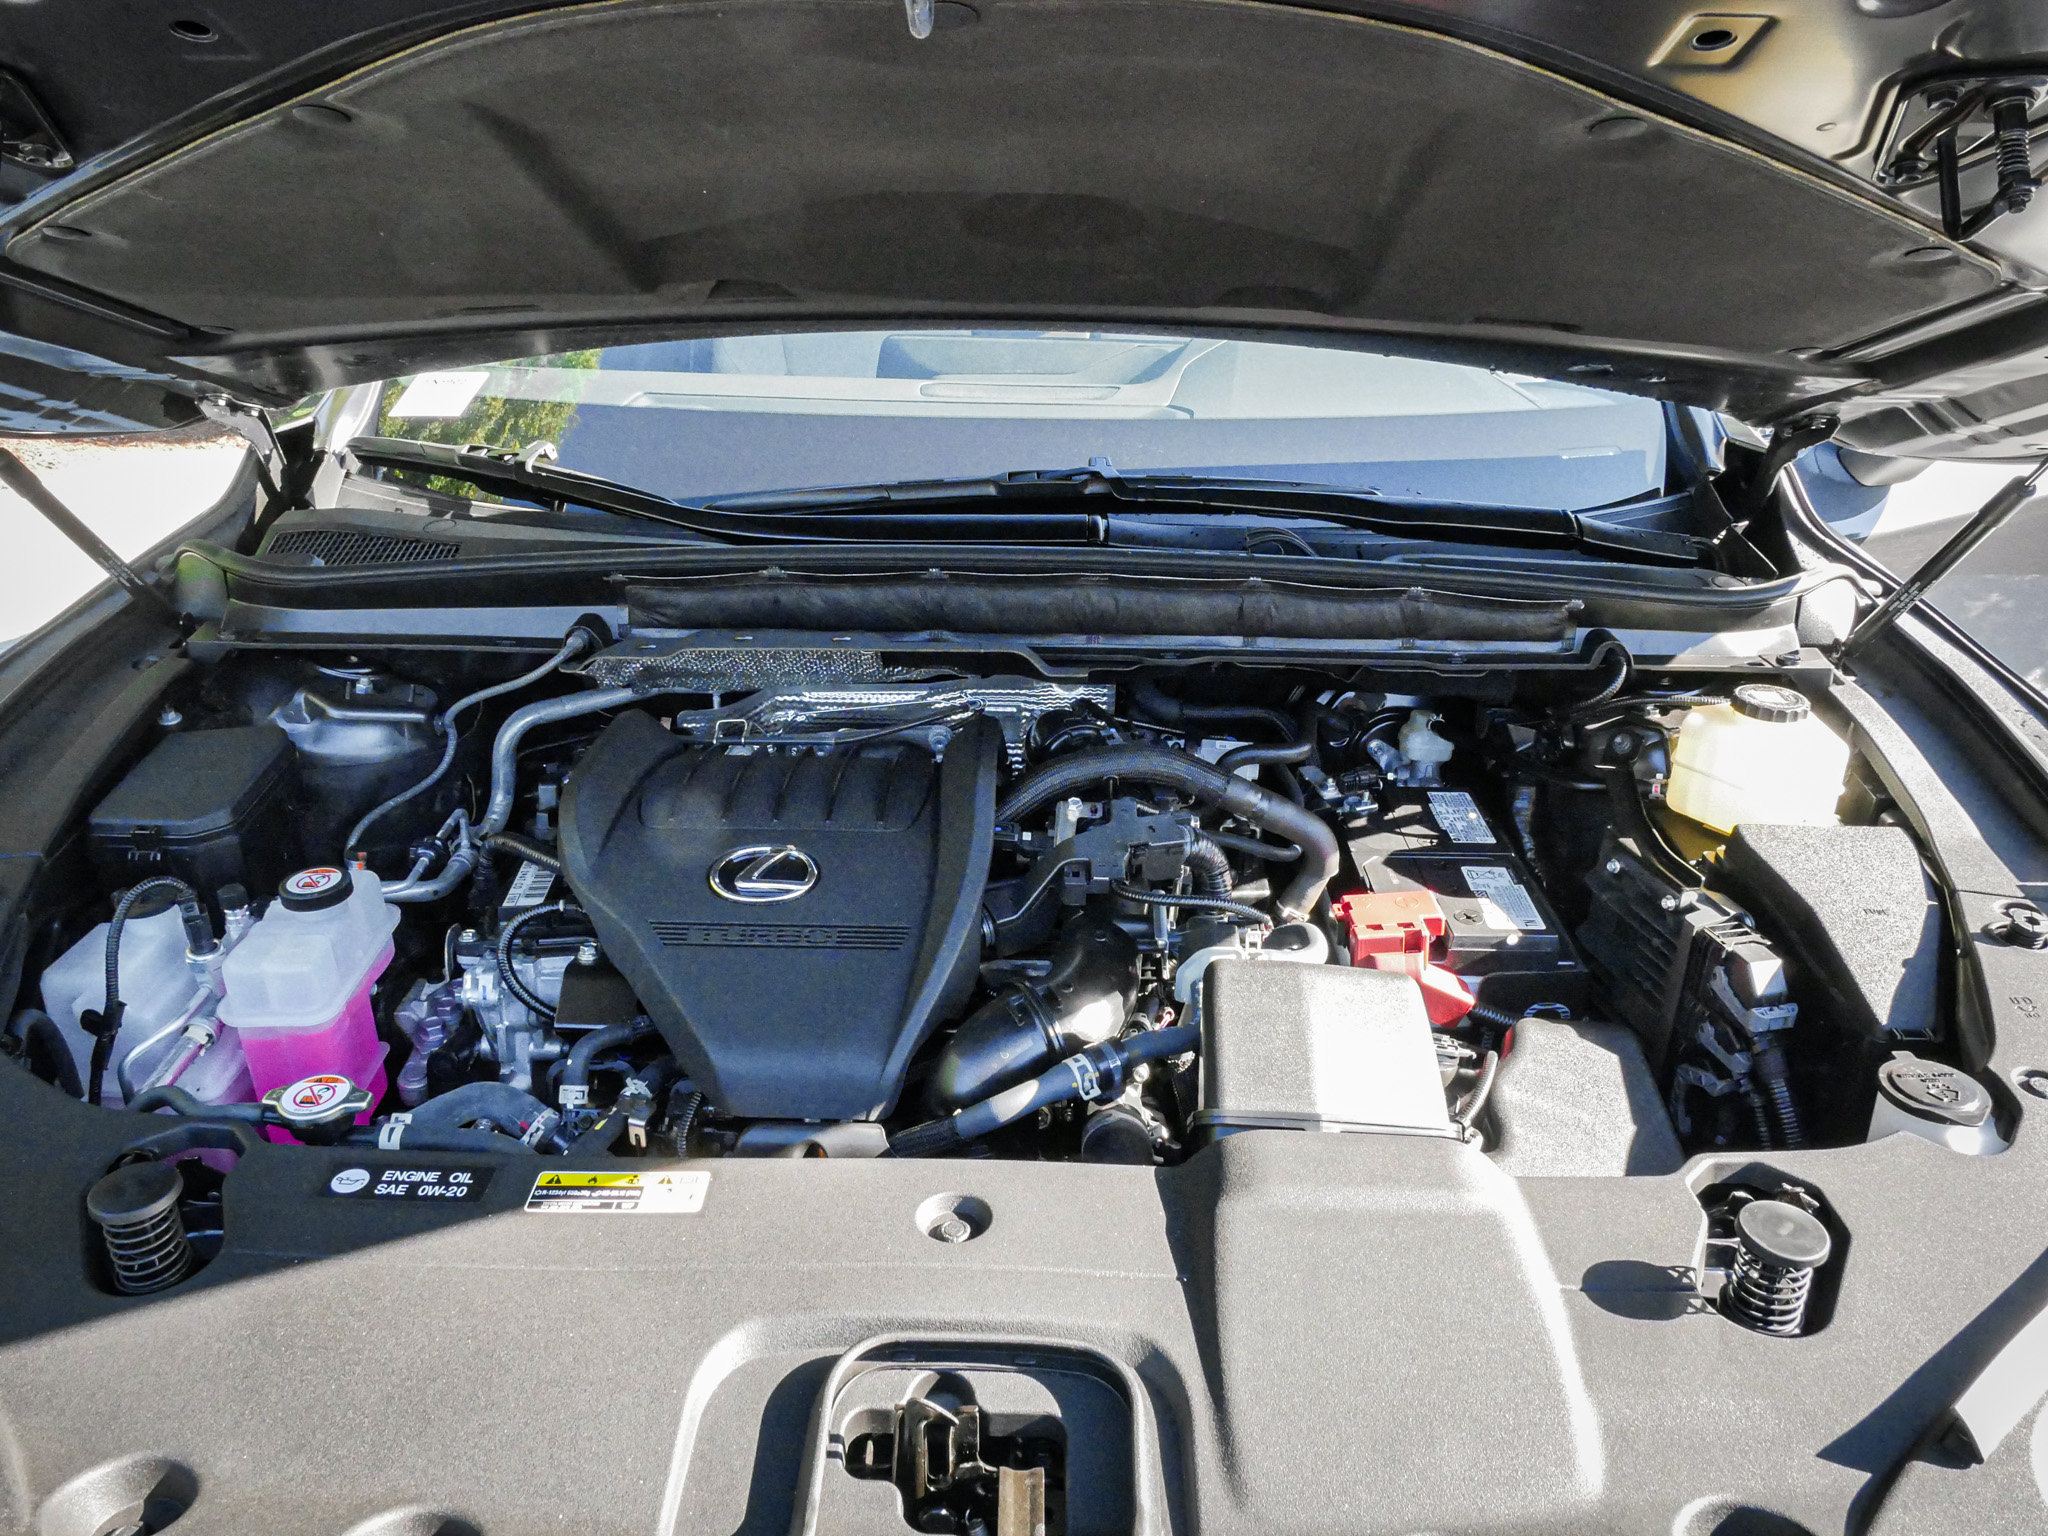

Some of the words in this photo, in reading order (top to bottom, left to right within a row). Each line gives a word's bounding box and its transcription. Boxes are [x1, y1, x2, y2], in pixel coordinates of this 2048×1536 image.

[690, 928, 833, 944] TURBO
[381, 1170, 441, 1183] ENGINE
[448, 1172, 474, 1184] OIL
[374, 1184, 409, 1196] SAE
[417, 1185, 468, 1198] 0W-20
